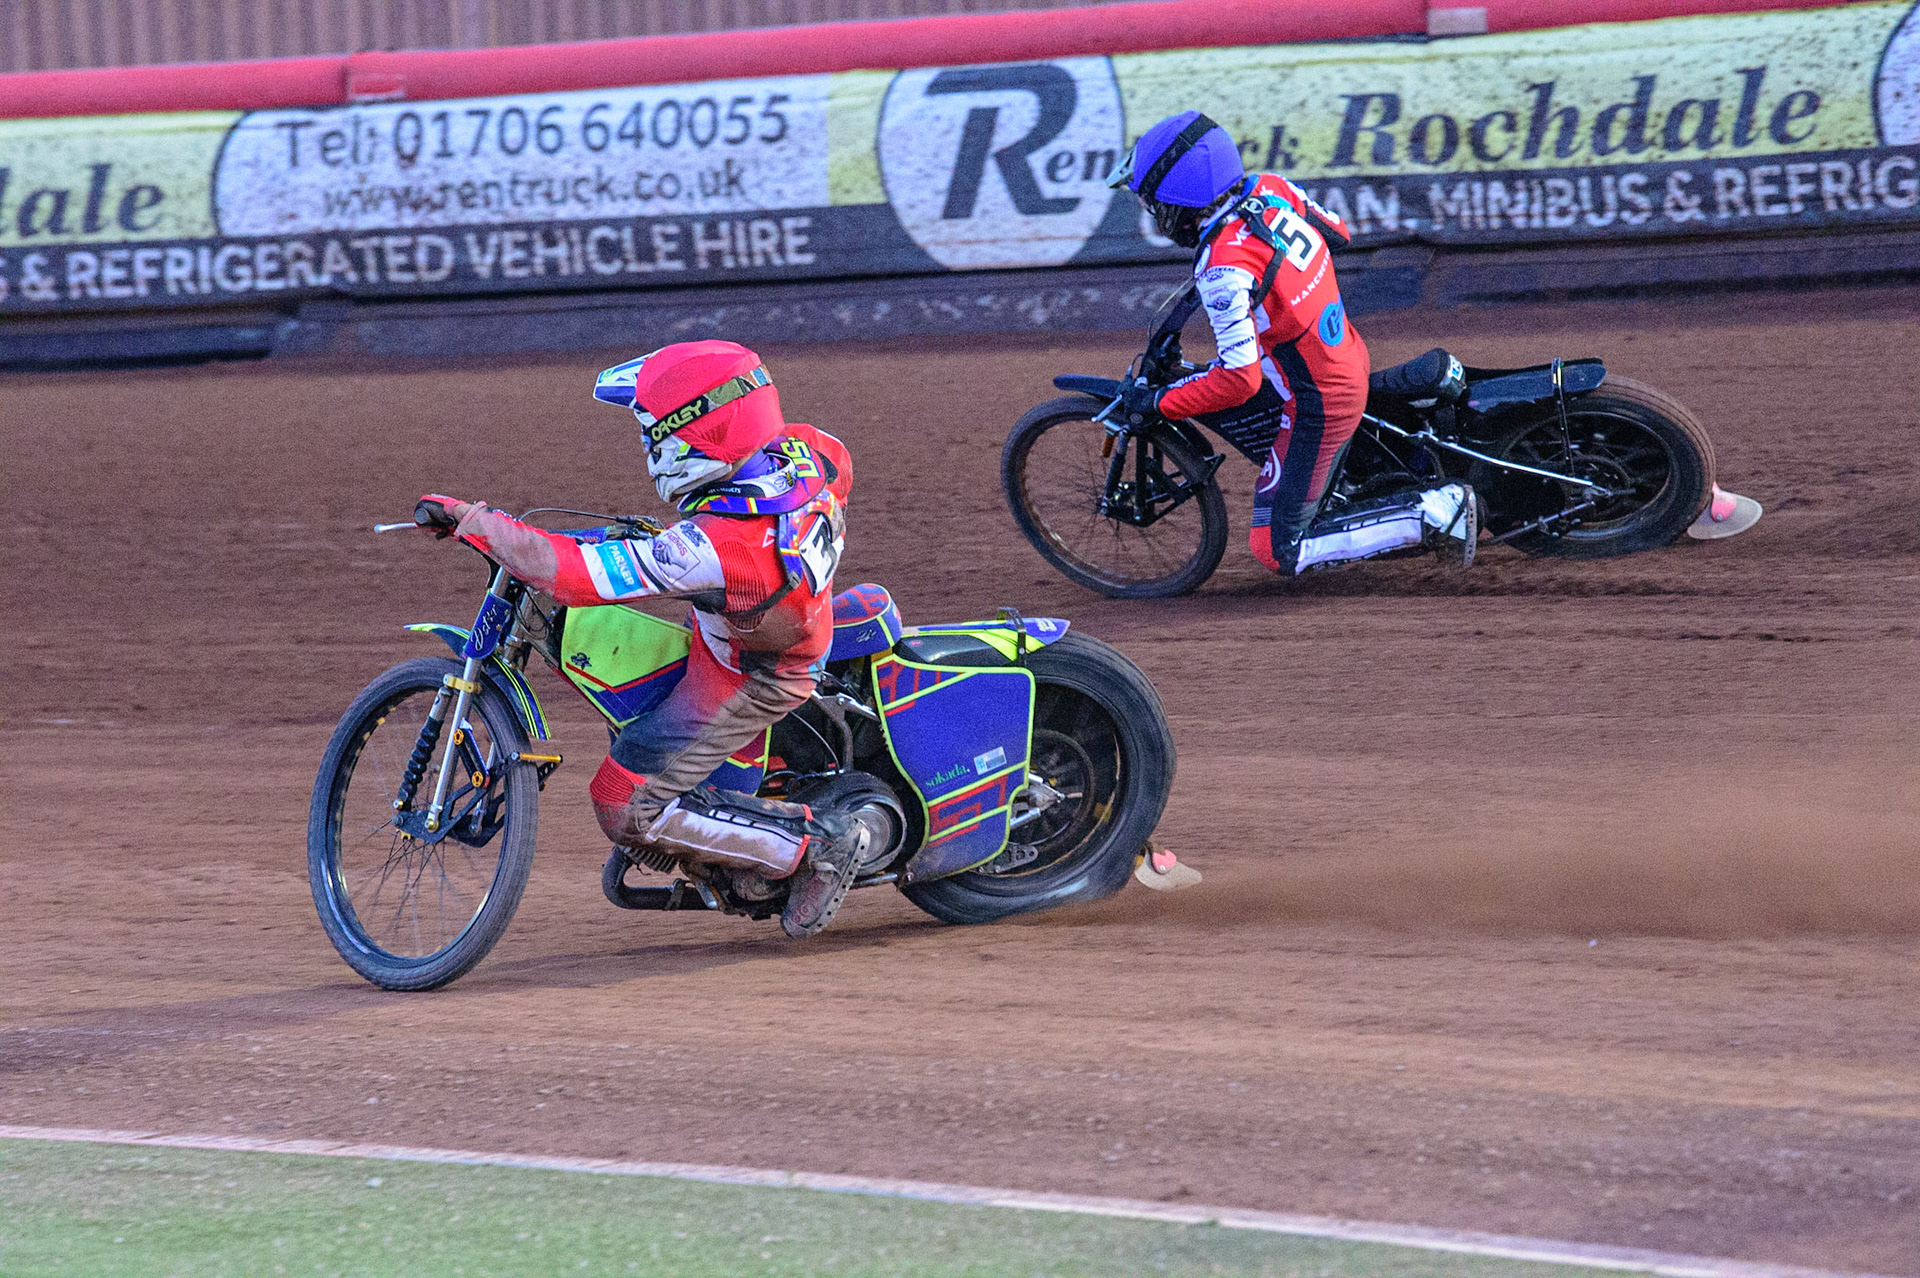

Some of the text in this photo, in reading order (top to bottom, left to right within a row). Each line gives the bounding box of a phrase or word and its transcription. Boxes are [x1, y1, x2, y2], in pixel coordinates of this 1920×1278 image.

[393, 105, 566, 161] 01706
[581, 93, 790, 153] 640055
[1322, 65, 1823, 168] Rochdale
[322, 157, 746, 217] www.rentruck.co.uk
[1426, 171, 1654, 232] MINIBUS
[1662, 169, 1706, 224] &
[18, 252, 59, 301] &
[66, 232, 456, 301] REFRIGERATED
[463, 223, 687, 281] VEHICLE
[691, 216, 817, 271] HIRE
[1273, 216, 1313, 261] 5
[651, 399, 703, 442] OAKLEY
[608, 544, 635, 586] PARKER
